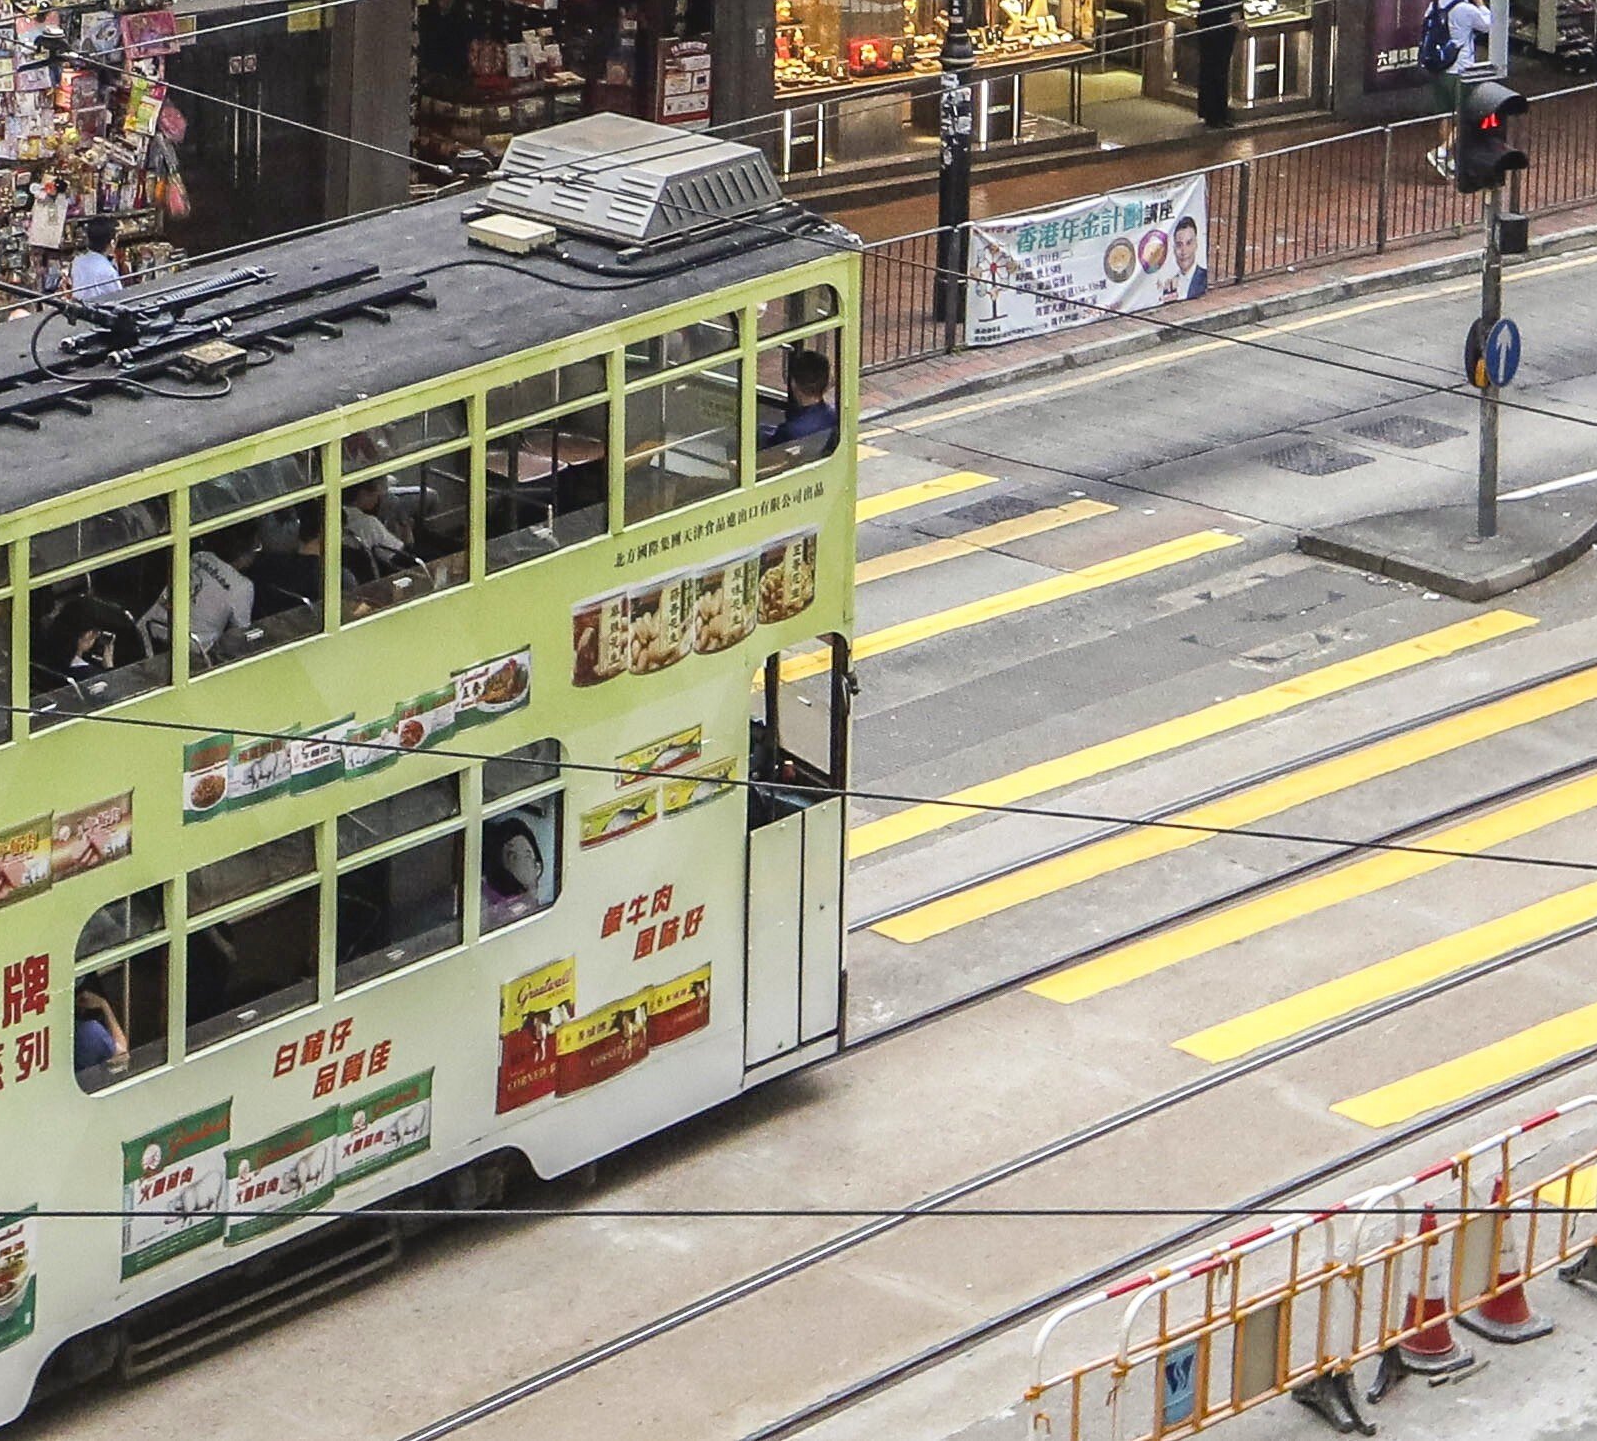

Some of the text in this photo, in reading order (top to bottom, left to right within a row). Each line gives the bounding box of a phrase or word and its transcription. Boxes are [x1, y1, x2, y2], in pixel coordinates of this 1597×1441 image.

[633, 904, 706, 961] 風味好
[313, 1039, 393, 1100] 品質佳
